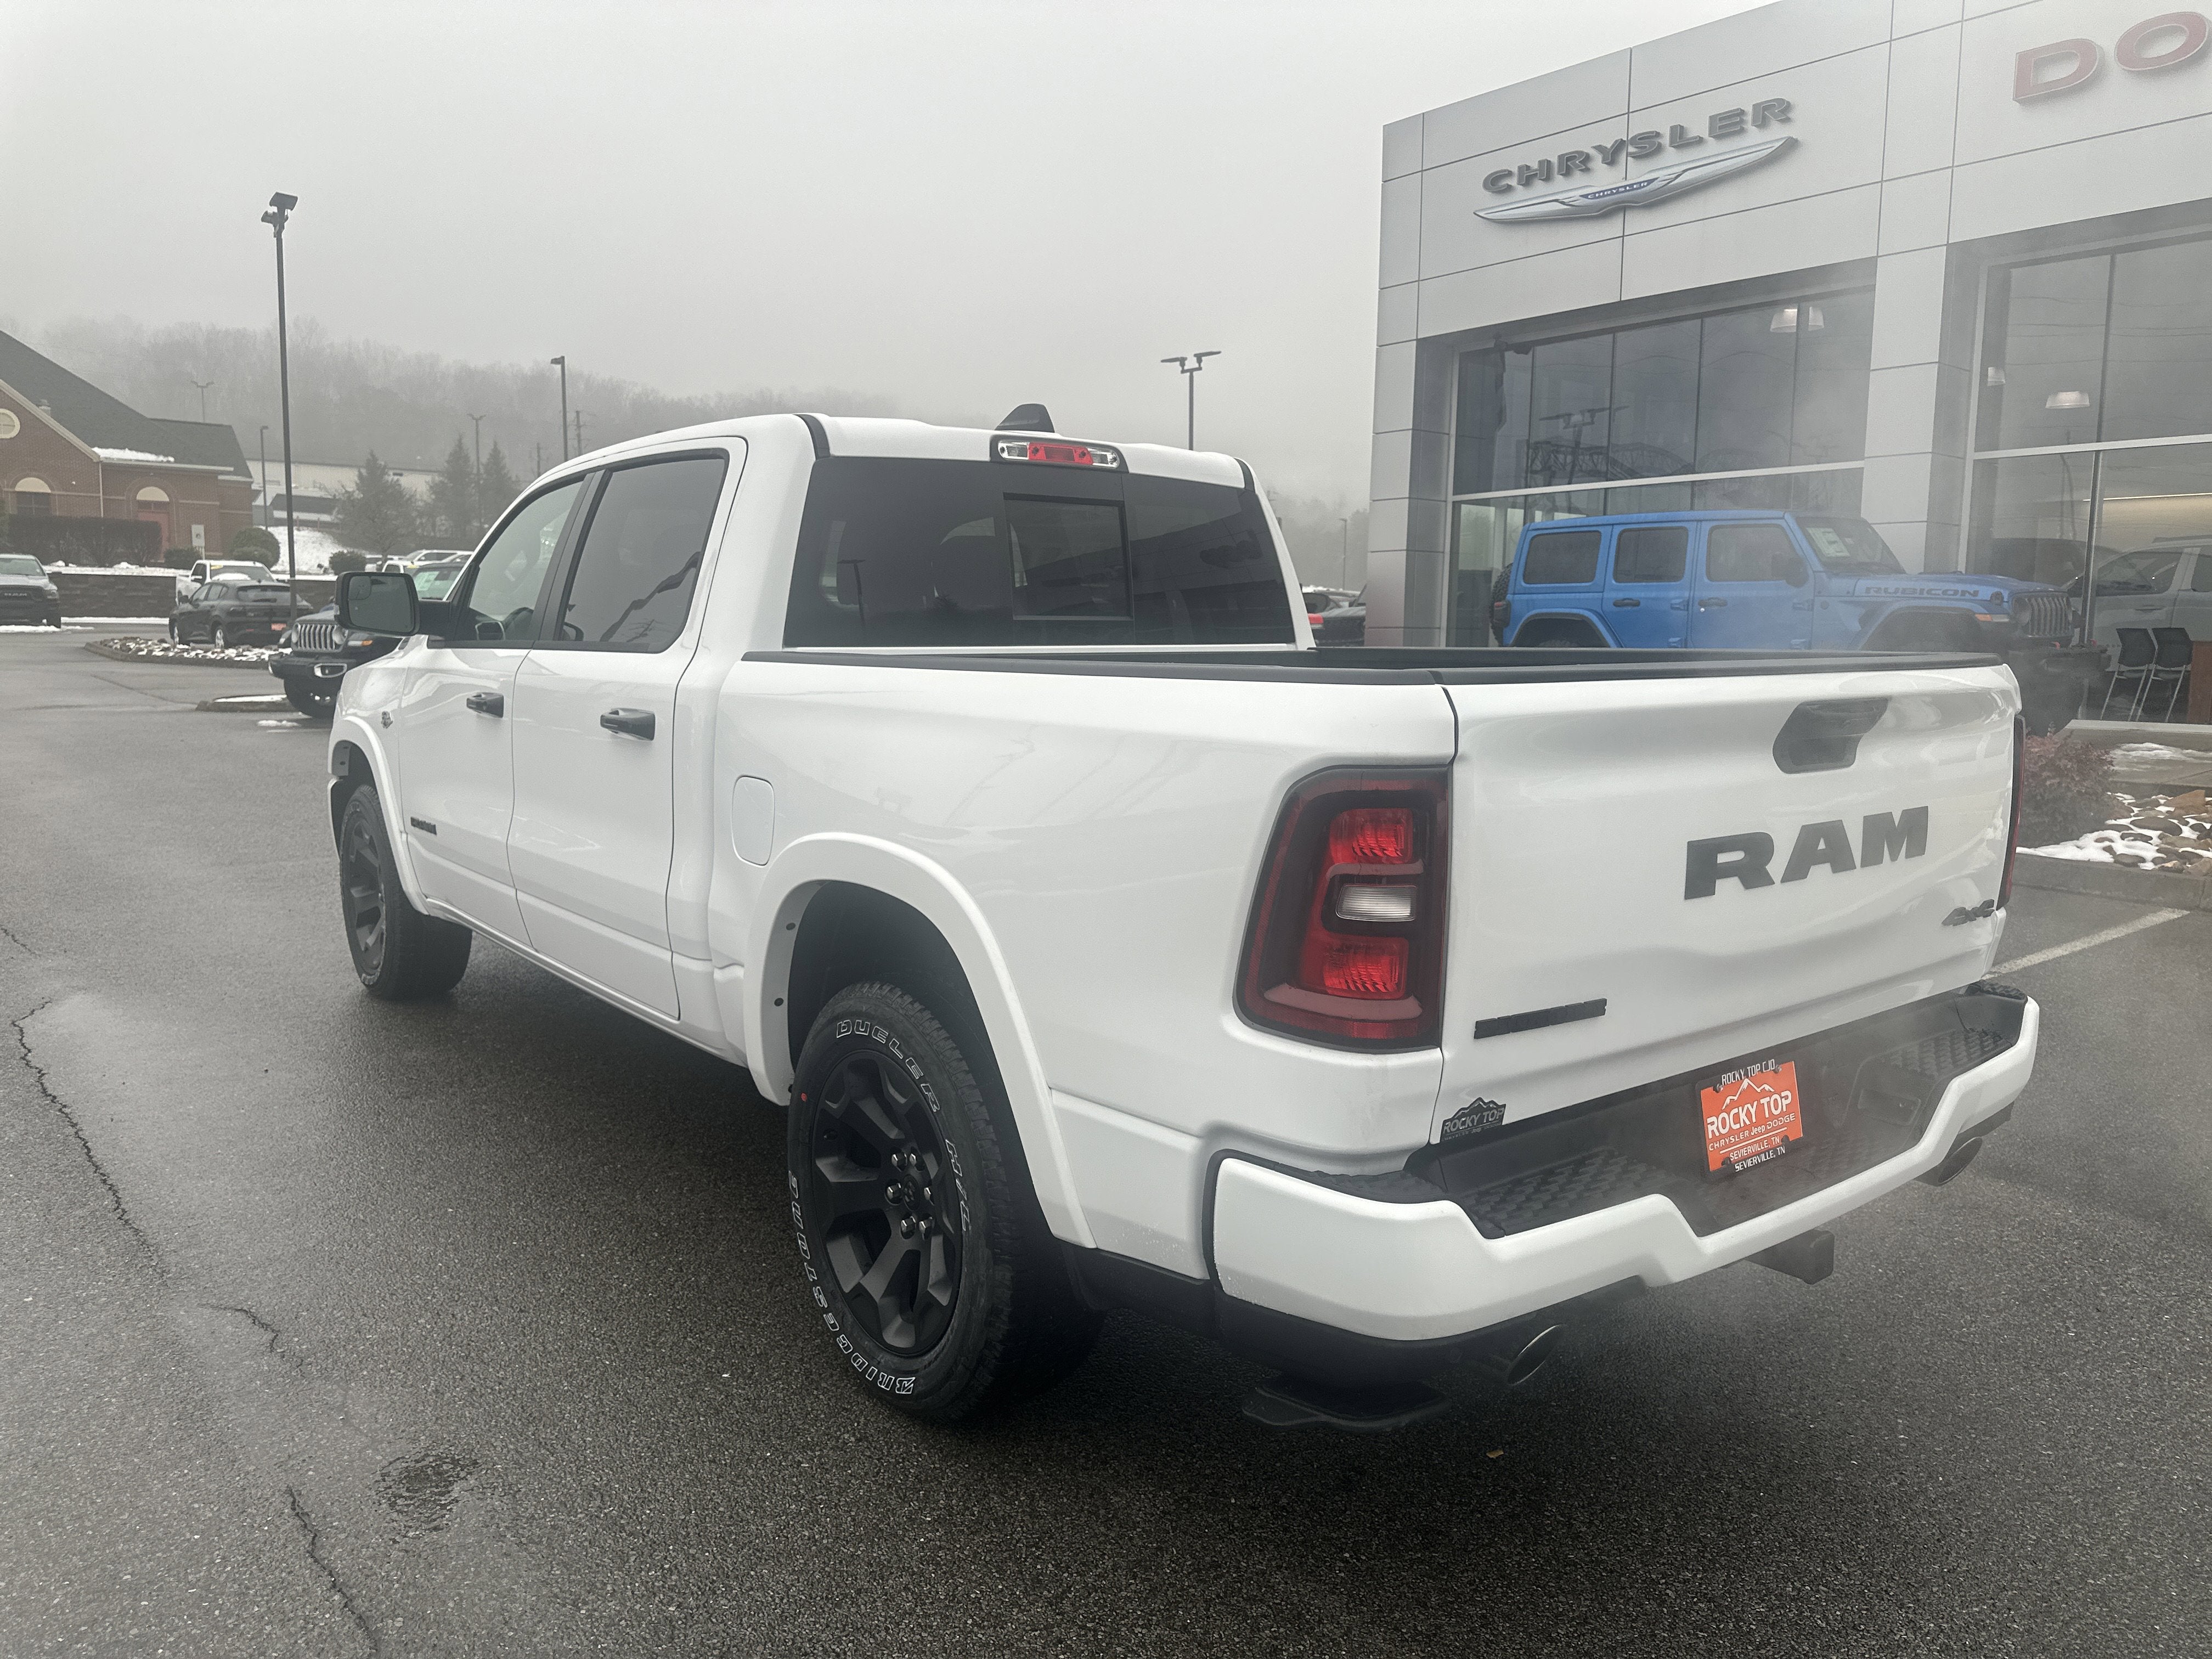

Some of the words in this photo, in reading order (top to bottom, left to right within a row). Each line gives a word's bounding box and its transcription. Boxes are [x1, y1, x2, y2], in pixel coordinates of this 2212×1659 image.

[2013, 12, 2210, 101] DO
[1482, 97, 1792, 193] CHRYSLER
[1588, 182, 1648, 199] CHRYSLER
[1865, 586, 1980, 597] RUBICON
[1684, 805, 1929, 900] RAM
[836, 1019, 940, 1113] DUELER
[1721, 1069, 1745, 1086] ROCKY
[1747, 1063, 1760, 1078] TOP
[1762, 1058, 1775, 1073] CJD
[1443, 1113, 1481, 1134] ROCKY
[1482, 1107, 1505, 1123] TOP
[1707, 1100, 1758, 1139] ROCKY
[1760, 1090, 1792, 1119] TOP
[1708, 1129, 1750, 1152] CHRYSLER
[1751, 1125, 1766, 1136] Jeep
[1767, 1112, 1796, 1130] DODGE
[1730, 1140, 1771, 1161] SEVIERVILLE,
[1771, 1136, 1780, 1145] TN
[1734, 1150, 1776, 1172] SEVIERVILLE,
[1777, 1146, 1786, 1155] TN
[788, 1170, 916, 1395] BRIDGESTONE
